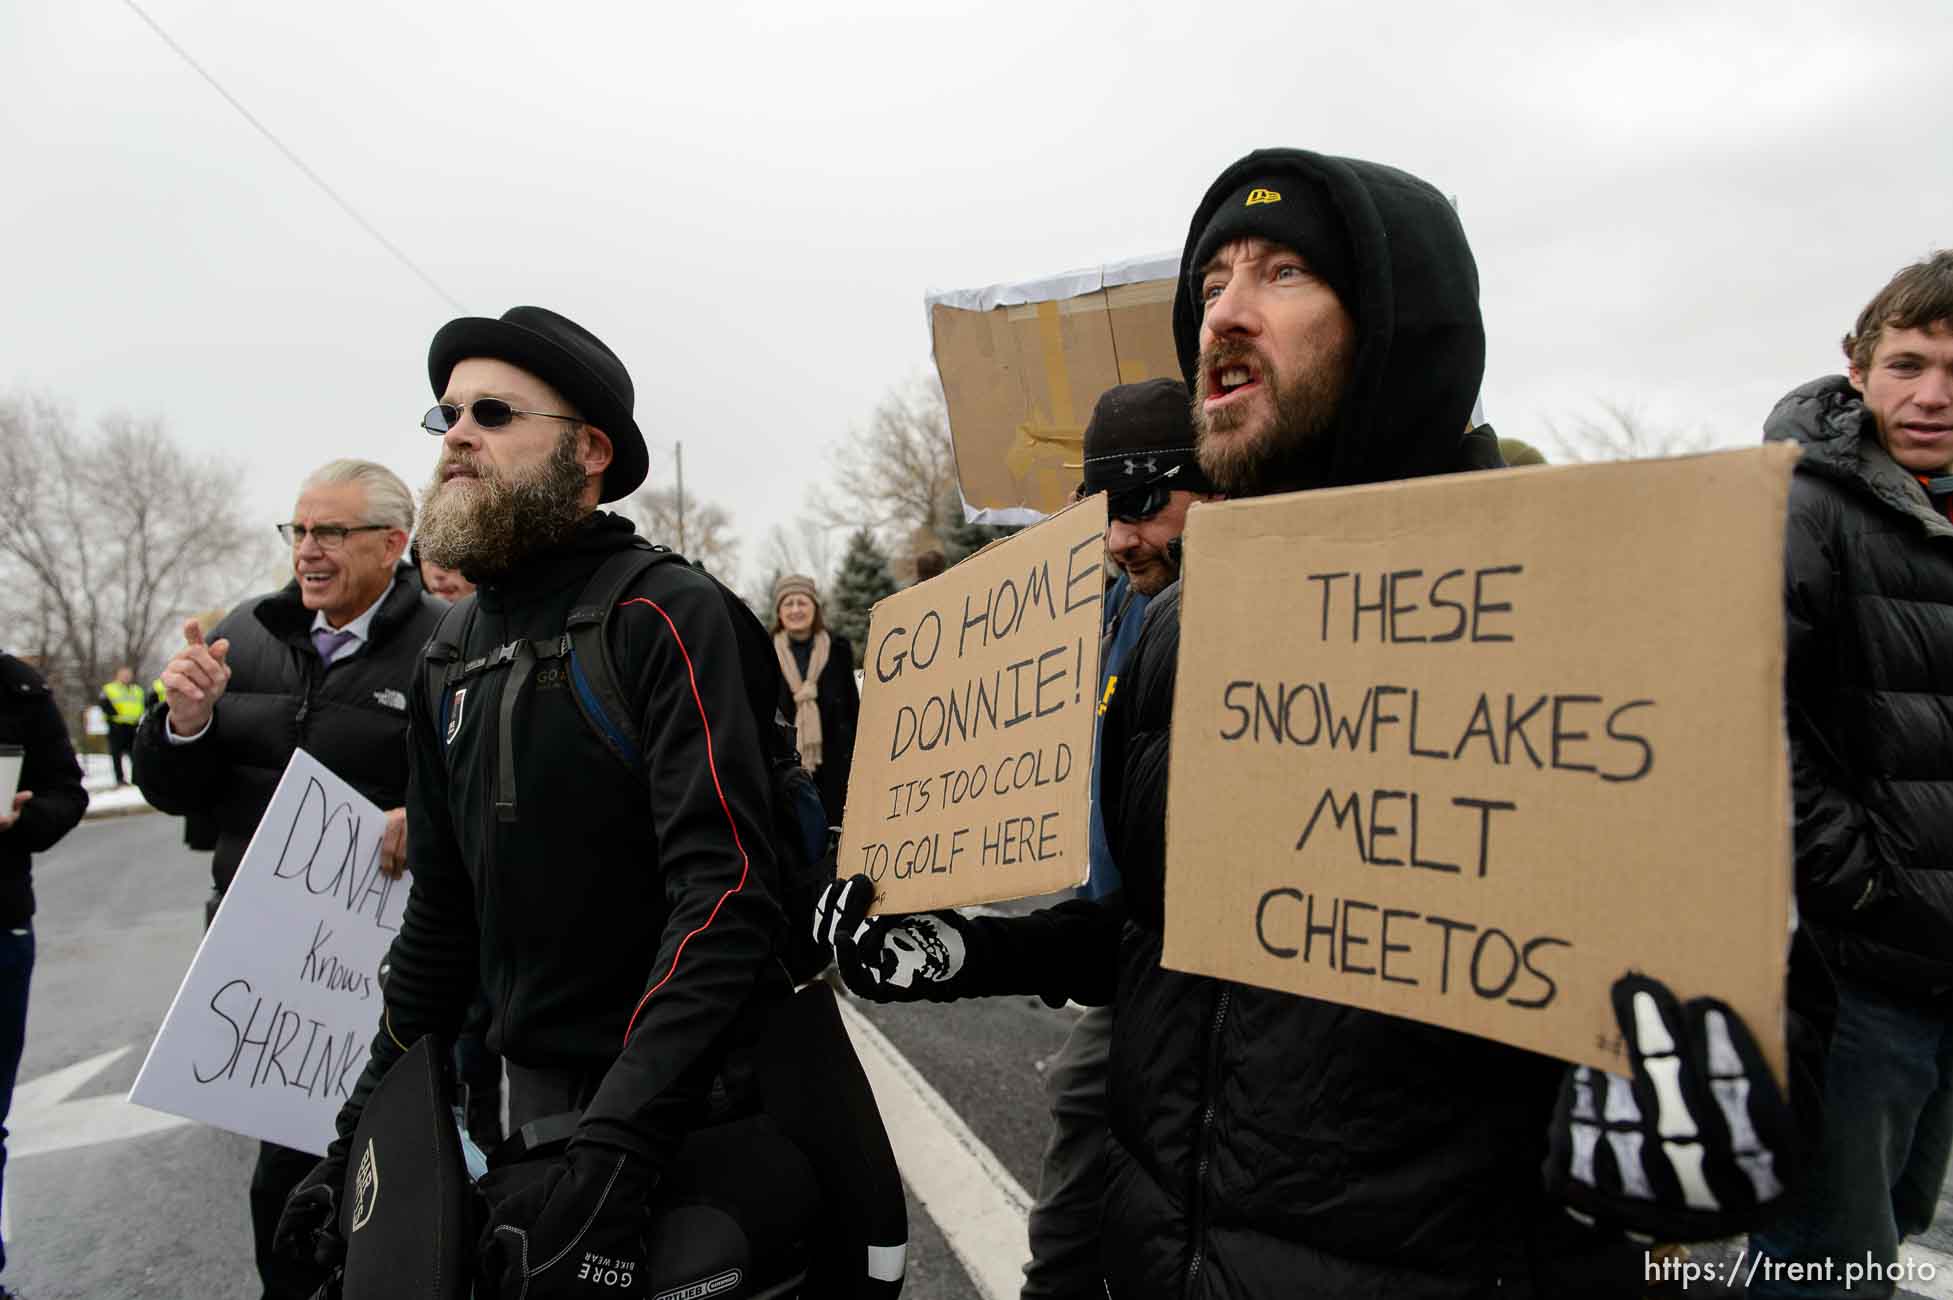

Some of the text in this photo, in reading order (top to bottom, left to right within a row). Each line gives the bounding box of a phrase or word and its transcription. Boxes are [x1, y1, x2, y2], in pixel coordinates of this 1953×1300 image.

[876, 533, 1105, 684] GO HOME
[1308, 564, 1524, 643] THESE
[889, 637, 1083, 762] DONNIE!
[1219, 681, 1657, 782] SNOWFLAKES
[939, 764, 988, 810] TOO
[994, 742, 1072, 796] COLD
[273, 775, 398, 932] DONAL
[861, 812, 1064, 882] TO GOLF HERE.
[1295, 787, 1517, 878] MELT
[1254, 887, 1573, 1009] CHEETOS
[577, 1262, 632, 1288] GORE
[584, 1251, 636, 1271] BIKE WEAR
